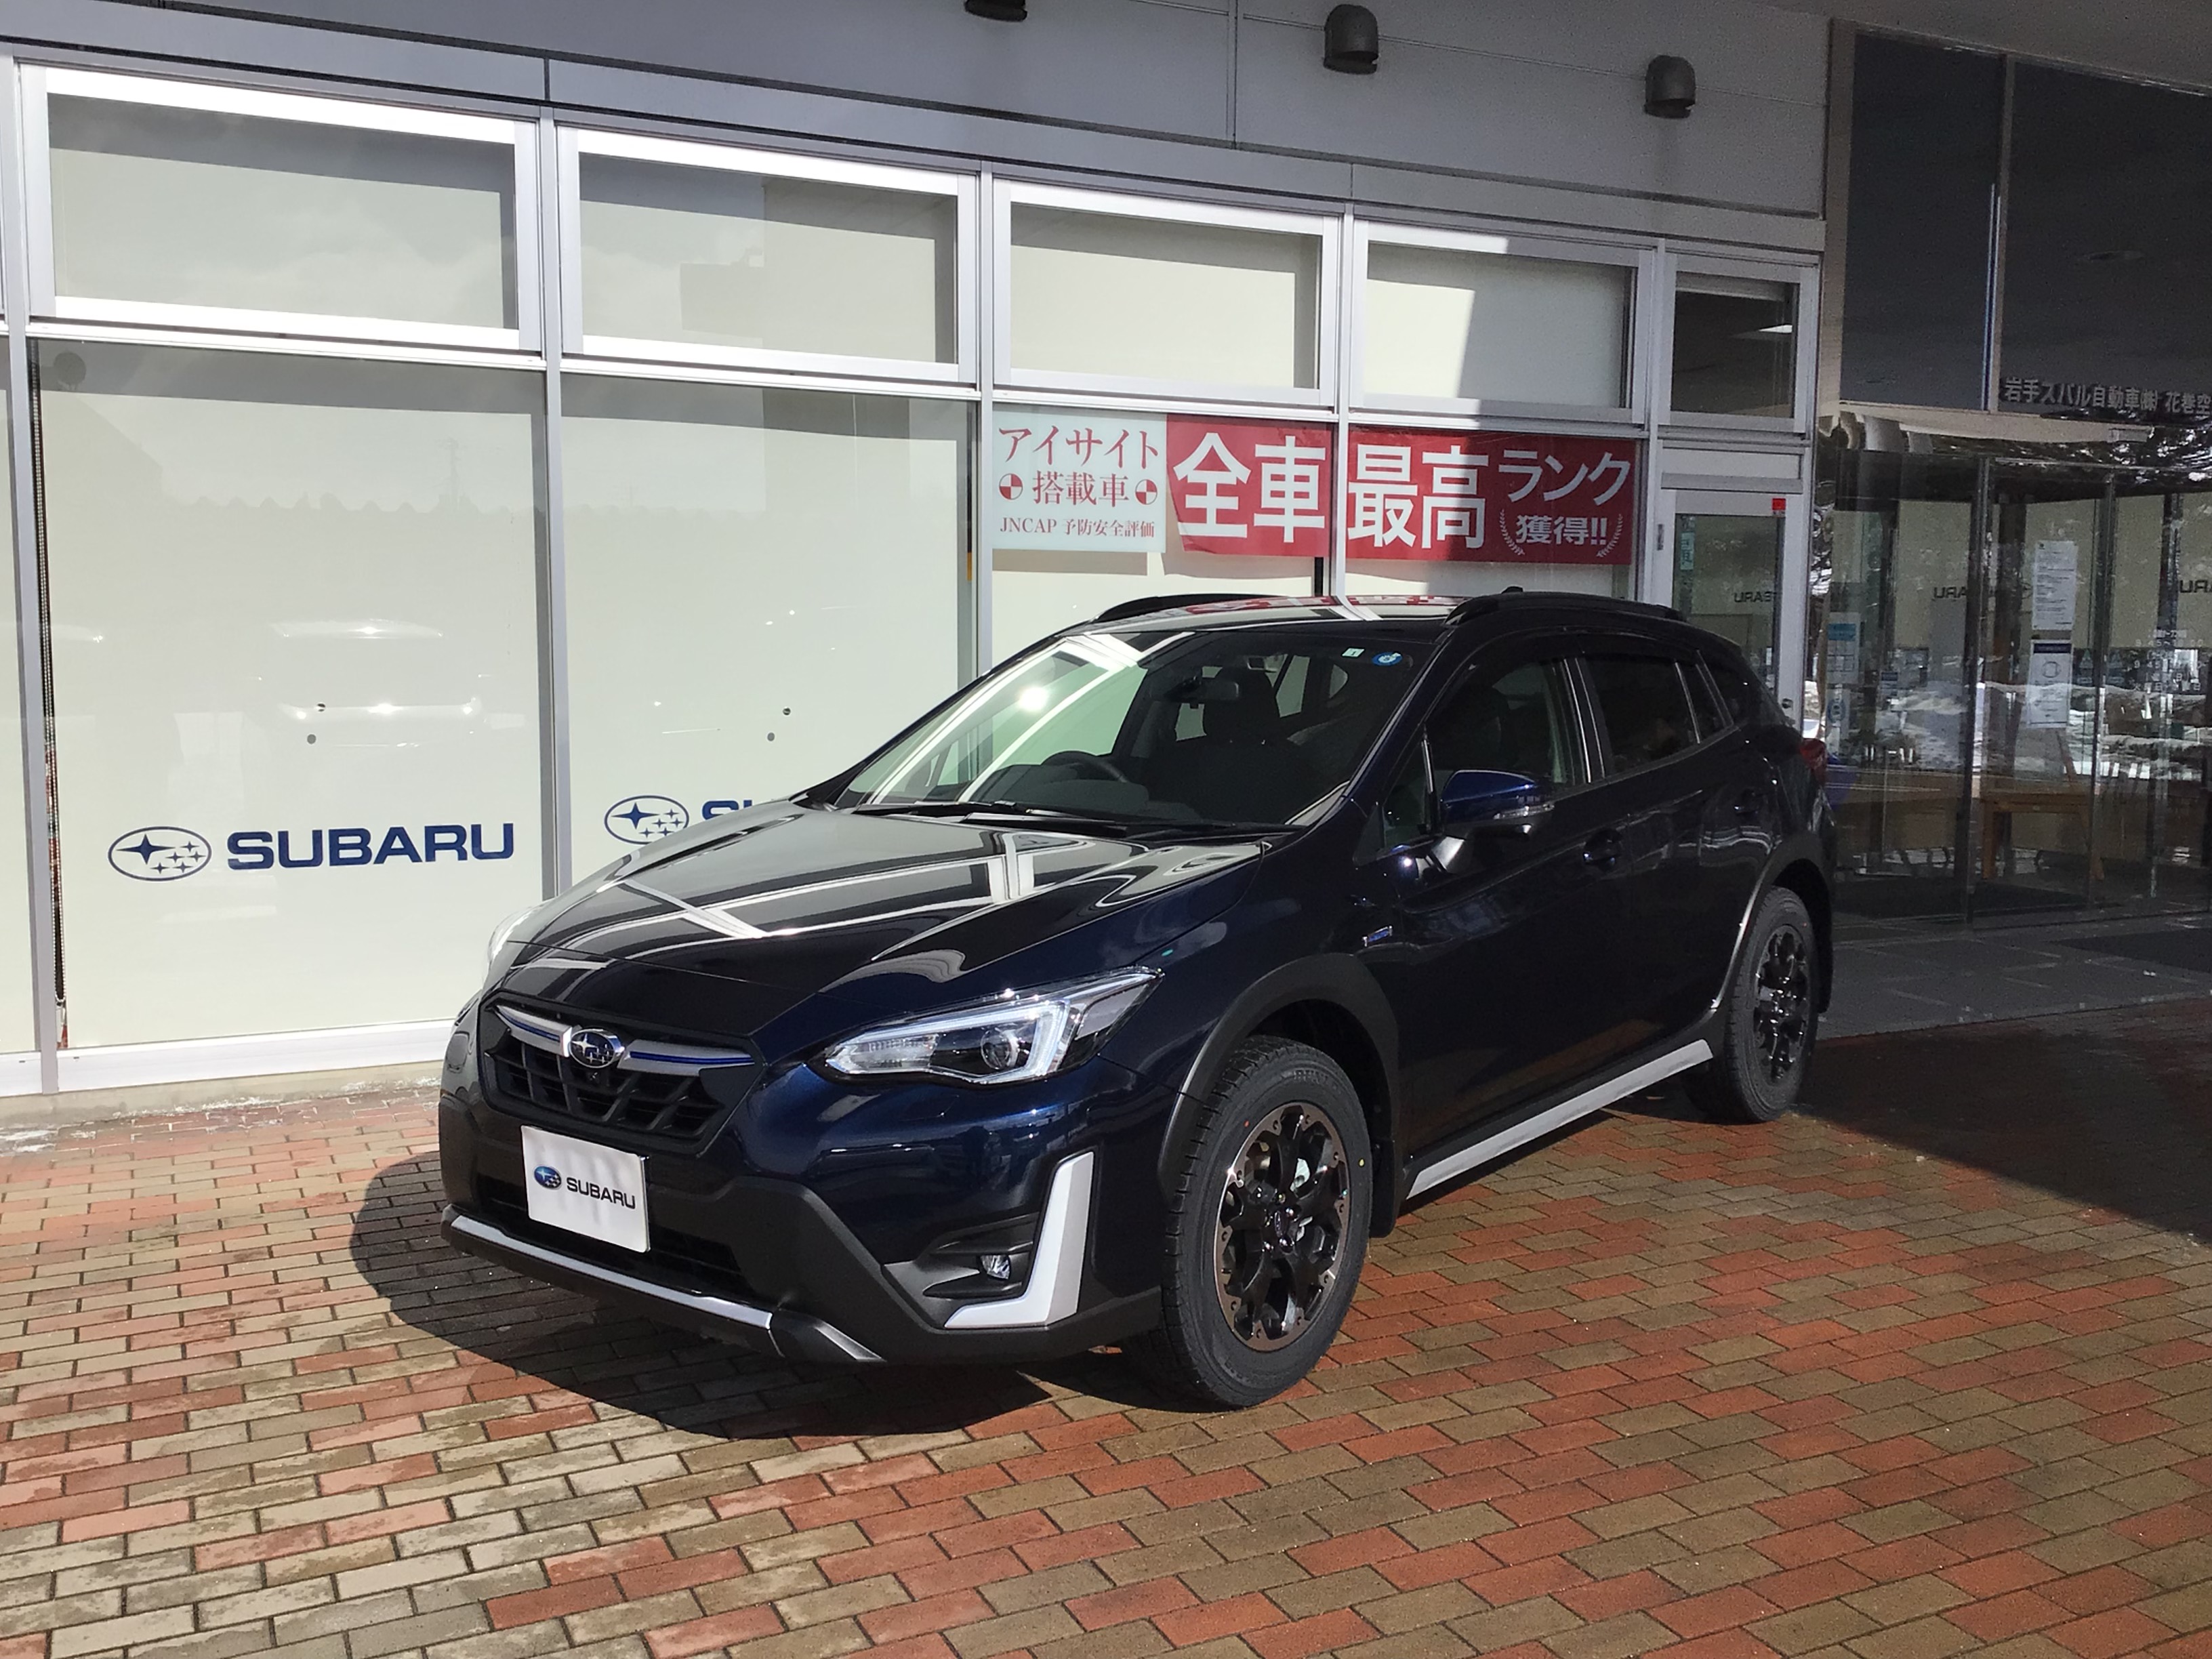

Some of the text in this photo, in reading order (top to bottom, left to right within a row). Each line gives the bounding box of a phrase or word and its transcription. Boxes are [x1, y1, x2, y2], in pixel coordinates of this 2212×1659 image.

[998, 425, 1159, 470] アイサイト
[1031, 470, 1130, 508] 搭載車
[1498, 449, 1631, 506] ランク
[1000, 516, 1155, 538] JNCAP 予防安全評価
[1515, 514, 1608, 546] 獲得!!
[226, 822, 514, 870] SUBARU
[566, 1176, 636, 1210] SUBARU
